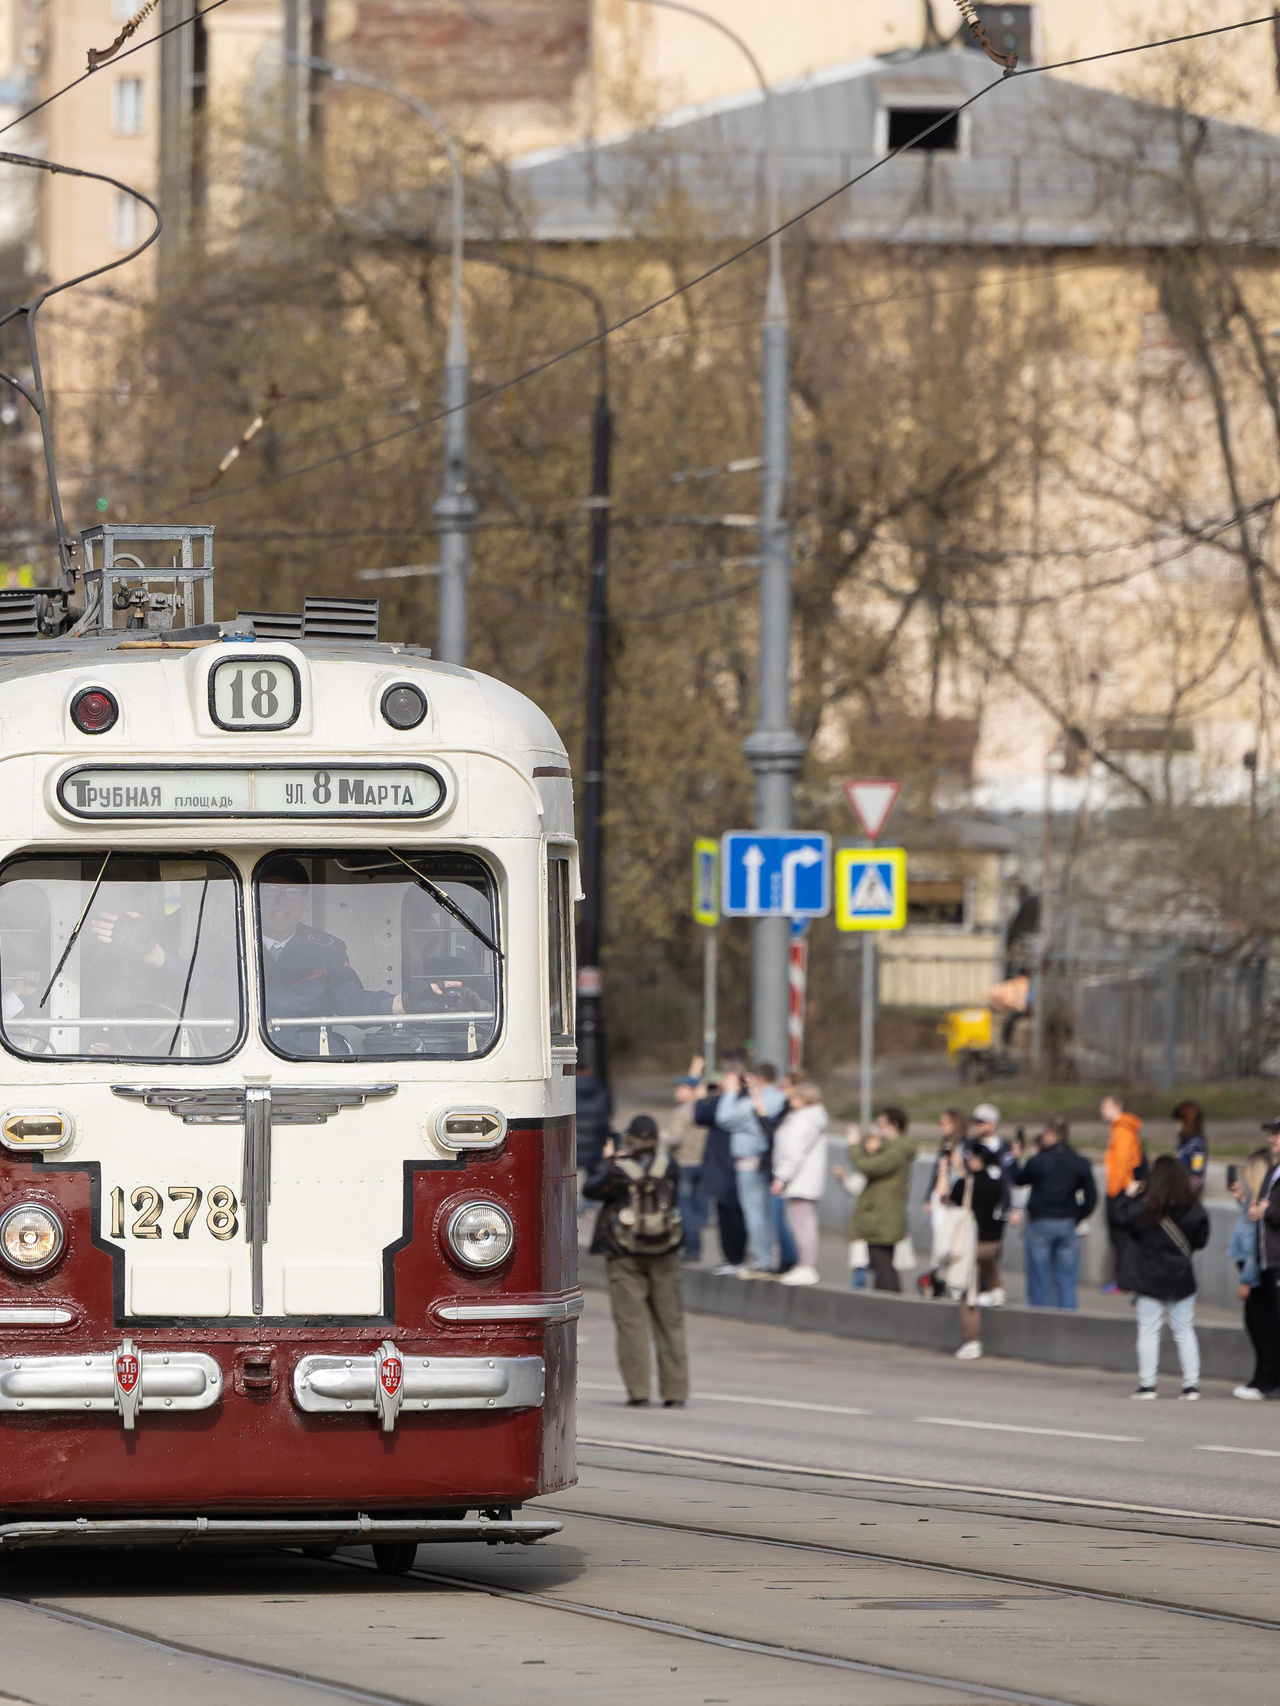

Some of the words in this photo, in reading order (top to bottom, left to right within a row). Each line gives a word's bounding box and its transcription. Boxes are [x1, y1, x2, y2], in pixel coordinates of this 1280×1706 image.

[229, 669, 279, 719] 18
[312, 770, 332, 805] 8
[110, 1185, 239, 1241] 1278
[121, 1374, 135, 1384] 82
[385, 1377, 399, 1387] 82
